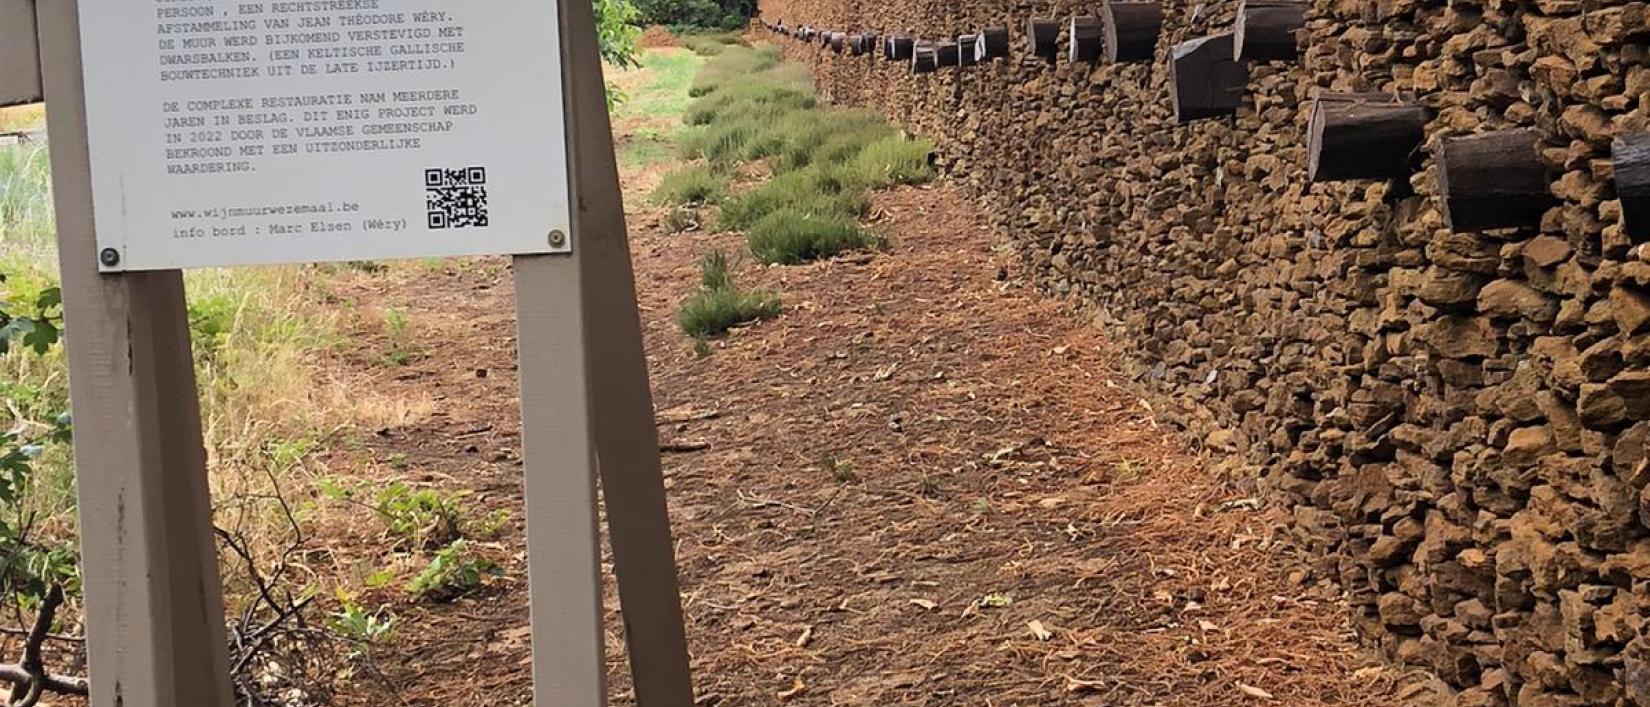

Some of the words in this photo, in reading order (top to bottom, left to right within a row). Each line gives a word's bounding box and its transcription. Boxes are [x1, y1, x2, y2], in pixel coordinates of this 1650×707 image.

[157, 6, 214, 18] PERSOON
[238, 4, 263, 14] EEN
[272, 0, 379, 12] RECHTSTREEKSE
[157, 20, 256, 34] AFSTAMMELING
[264, 19, 288, 29] VAN
[297, 17, 330, 28] JEAN
[339, 13, 404, 26] THÉODORE
[412, 10, 452, 22] WÉRY.
[159, 39, 174, 50] DE
[183, 38, 216, 48] MUUR
[224, 36, 257, 46] WERD
[265, 32, 340, 45] BIJKOMEND
[348, 28, 431, 41] VERSTEVIGD
[438, 27, 463, 38] MET
[160, 52, 256, 65] DWARSBALKEN.
[269, 50, 299, 61] (EEN
[308, 46, 382, 58] KELTISCHE
[390, 42, 464, 55] GALLISCHE
[160, 67, 260, 81] BOUWTECHNIEK
[268, 66, 292, 76] UIT
[300, 64, 317, 75] DE
[326, 62, 358, 74] LATE
[368, 59, 455, 72] IJZERTIJD.)
[163, 102, 179, 112] DE
[187, 98, 253, 111] COMPLEXE
[262, 94, 352, 108] RESTAURATIE
[360, 93, 385, 104] NAM
[393, 90, 459, 102] MEERDERE
[164, 116, 205, 128] JAREN
[214, 115, 229, 126] IN
[238, 113, 294, 125] BESLAG.
[304, 111, 328, 122] DIT
[336, 109, 370, 120] ENIG
[378, 106, 435, 118] PROJECT
[443, 104, 477, 116] WERD
[166, 133, 182, 144] IN
[190, 131, 222, 142] 2022
[231, 130, 264, 140] DOOR
[272, 128, 288, 138] DE
[296, 126, 353, 137] VLAAMSE
[362, 122, 453, 134] GEMEENSCHAP
[166, 146, 232, 159] BEKROOND
[240, 145, 264, 156] MET
[272, 144, 297, 154] EEN
[306, 138, 421, 152] UITZONDERLIJKE
[167, 162, 256, 174] WAARDERING.
[171, 202, 359, 219] www.wijnmuurwezemaal.be
[174, 227, 205, 238] info
[212, 225, 246, 237] bord
[269, 224, 302, 234] Marc
[310, 222, 351, 232] Elsen
[362, 219, 406, 231] (Wéry)
